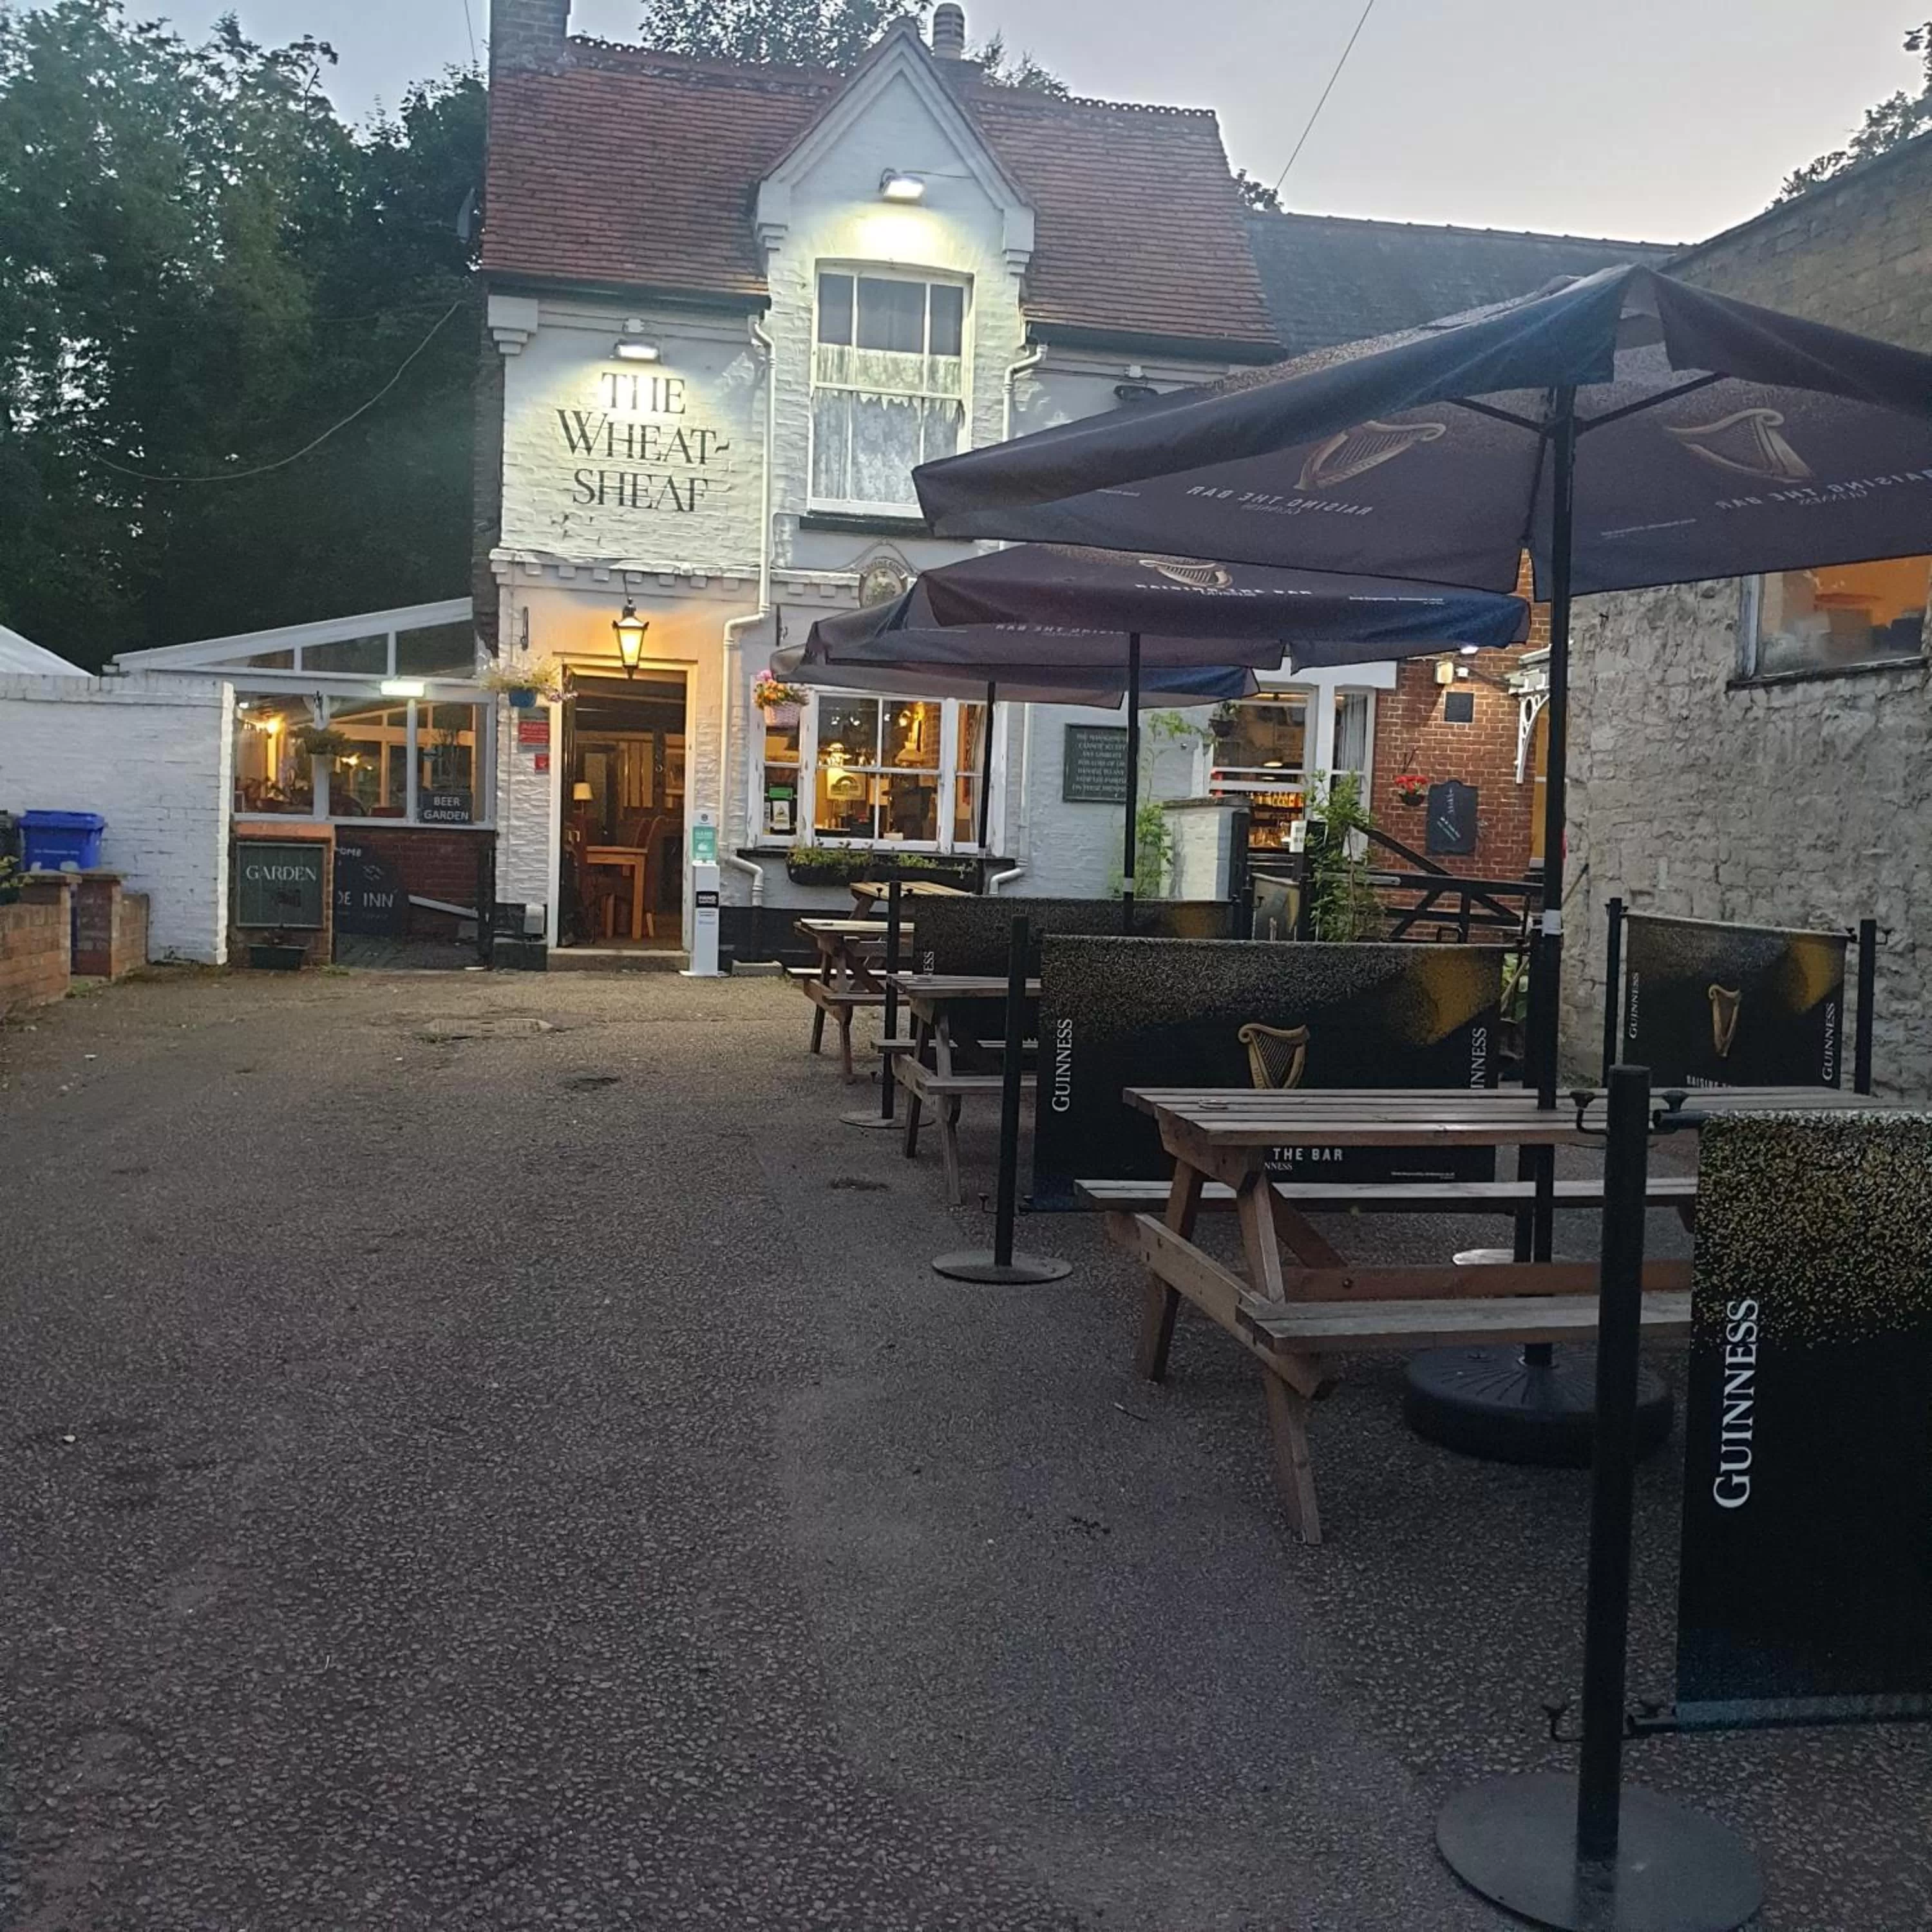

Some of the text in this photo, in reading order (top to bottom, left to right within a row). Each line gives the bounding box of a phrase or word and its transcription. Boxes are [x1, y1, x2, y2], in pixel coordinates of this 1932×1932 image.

[602, 372, 686, 414] THE
[573, 468, 708, 513] SHEAF
[424, 809, 469, 820] GARDEN
[433, 796, 460, 806] BEER
[246, 865, 317, 882] GARDEN
[363, 892, 394, 907] INN
[1628, 972, 1639, 1039] GUINNESS
[1822, 1001, 1836, 1082] GUINNESS
[1052, 1018, 1073, 1113] GUINNESS
[1273, 1148, 1343, 1161] THE BAR
[1712, 1299, 1759, 1509] GUINNESS
